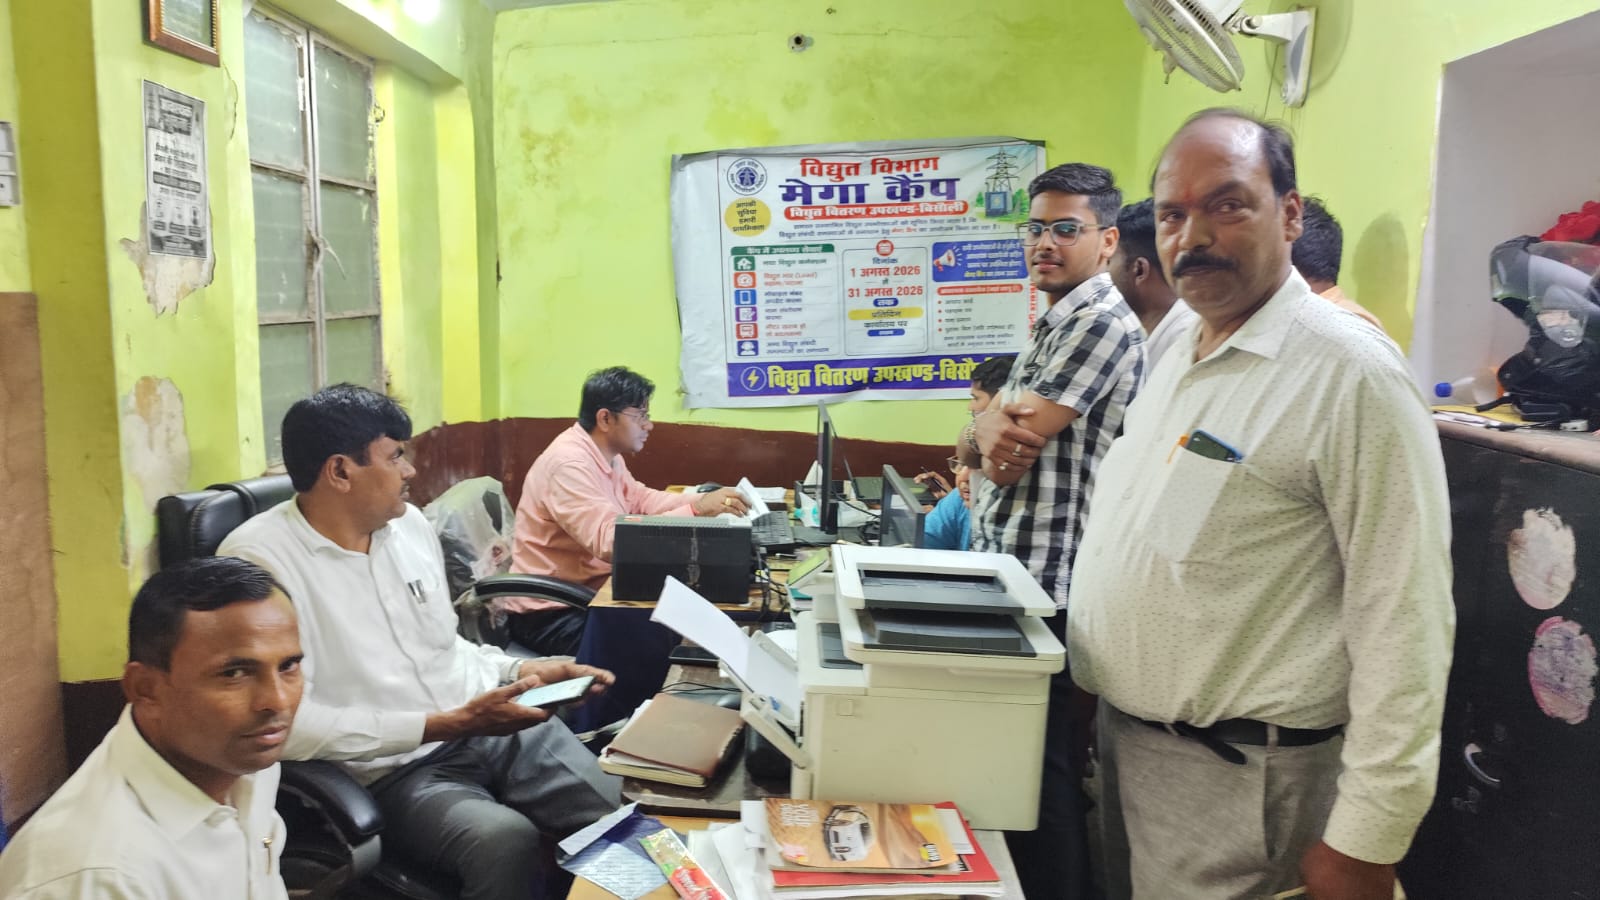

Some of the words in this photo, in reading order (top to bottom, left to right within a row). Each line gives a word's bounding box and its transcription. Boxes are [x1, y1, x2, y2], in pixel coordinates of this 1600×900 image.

[800, 158, 861, 182] विद्युत
[871, 157, 940, 175] विभाग
[778, 178, 870, 205] मेगा
[882, 173, 960, 202] कैंप
[790, 206, 822, 220] विद्युत
[825, 206, 867, 217] वितरण
[850, 268, 856, 277] 1
[860, 267, 890, 277] अगस्त
[894, 266, 921, 276] 2026
[848, 288, 860, 298] 31
[864, 288, 893, 297] अगस्त
[896, 286, 924, 296] 2026
[864, 320, 895, 328] कार्यालय
[766, 366, 812, 395] विद्युत
[814, 363, 869, 388] वितरण
